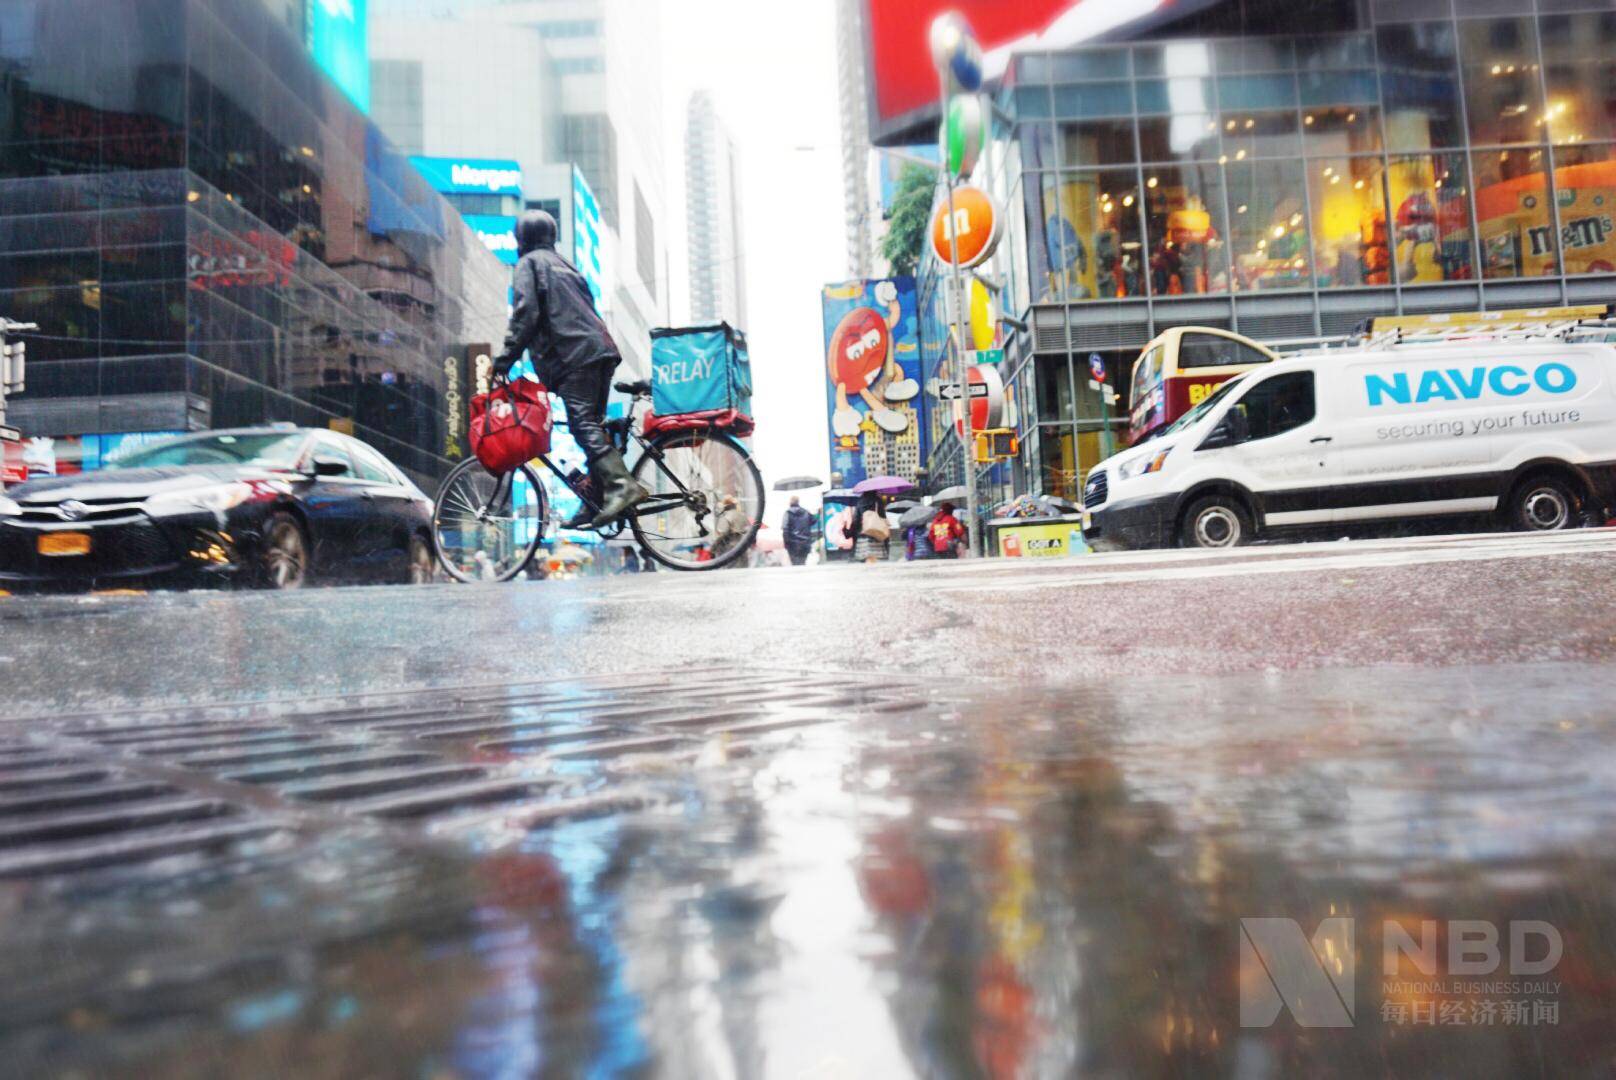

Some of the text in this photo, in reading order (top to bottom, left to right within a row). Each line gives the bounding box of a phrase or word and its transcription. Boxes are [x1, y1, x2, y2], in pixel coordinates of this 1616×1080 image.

[658, 356, 715, 385] RELAY
[1364, 362, 1577, 406] NAVCO
[1376, 407, 1581, 440] securing your future
